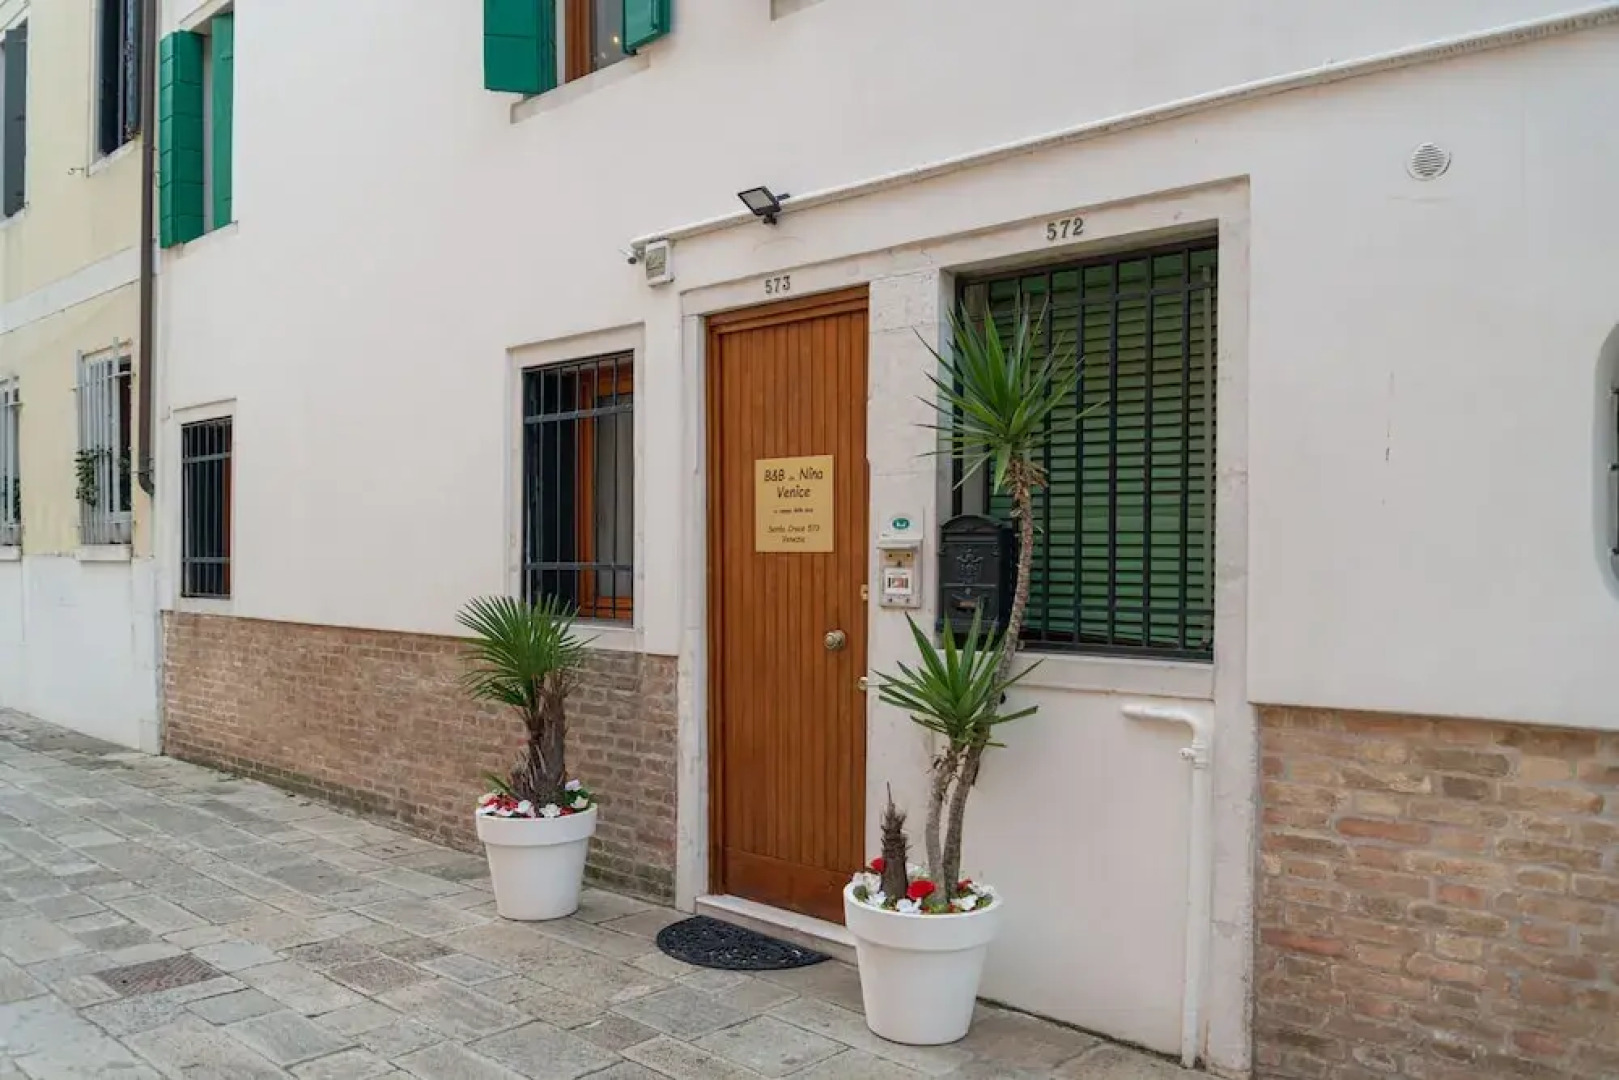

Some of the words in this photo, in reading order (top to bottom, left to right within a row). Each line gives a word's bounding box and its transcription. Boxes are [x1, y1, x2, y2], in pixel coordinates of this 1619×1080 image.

[1046, 216, 1084, 241] 572
[764, 274, 791, 294] 573
[764, 468, 785, 482] B&B
[799, 466, 823, 481] Nina
[776, 484, 811, 499] Venice
